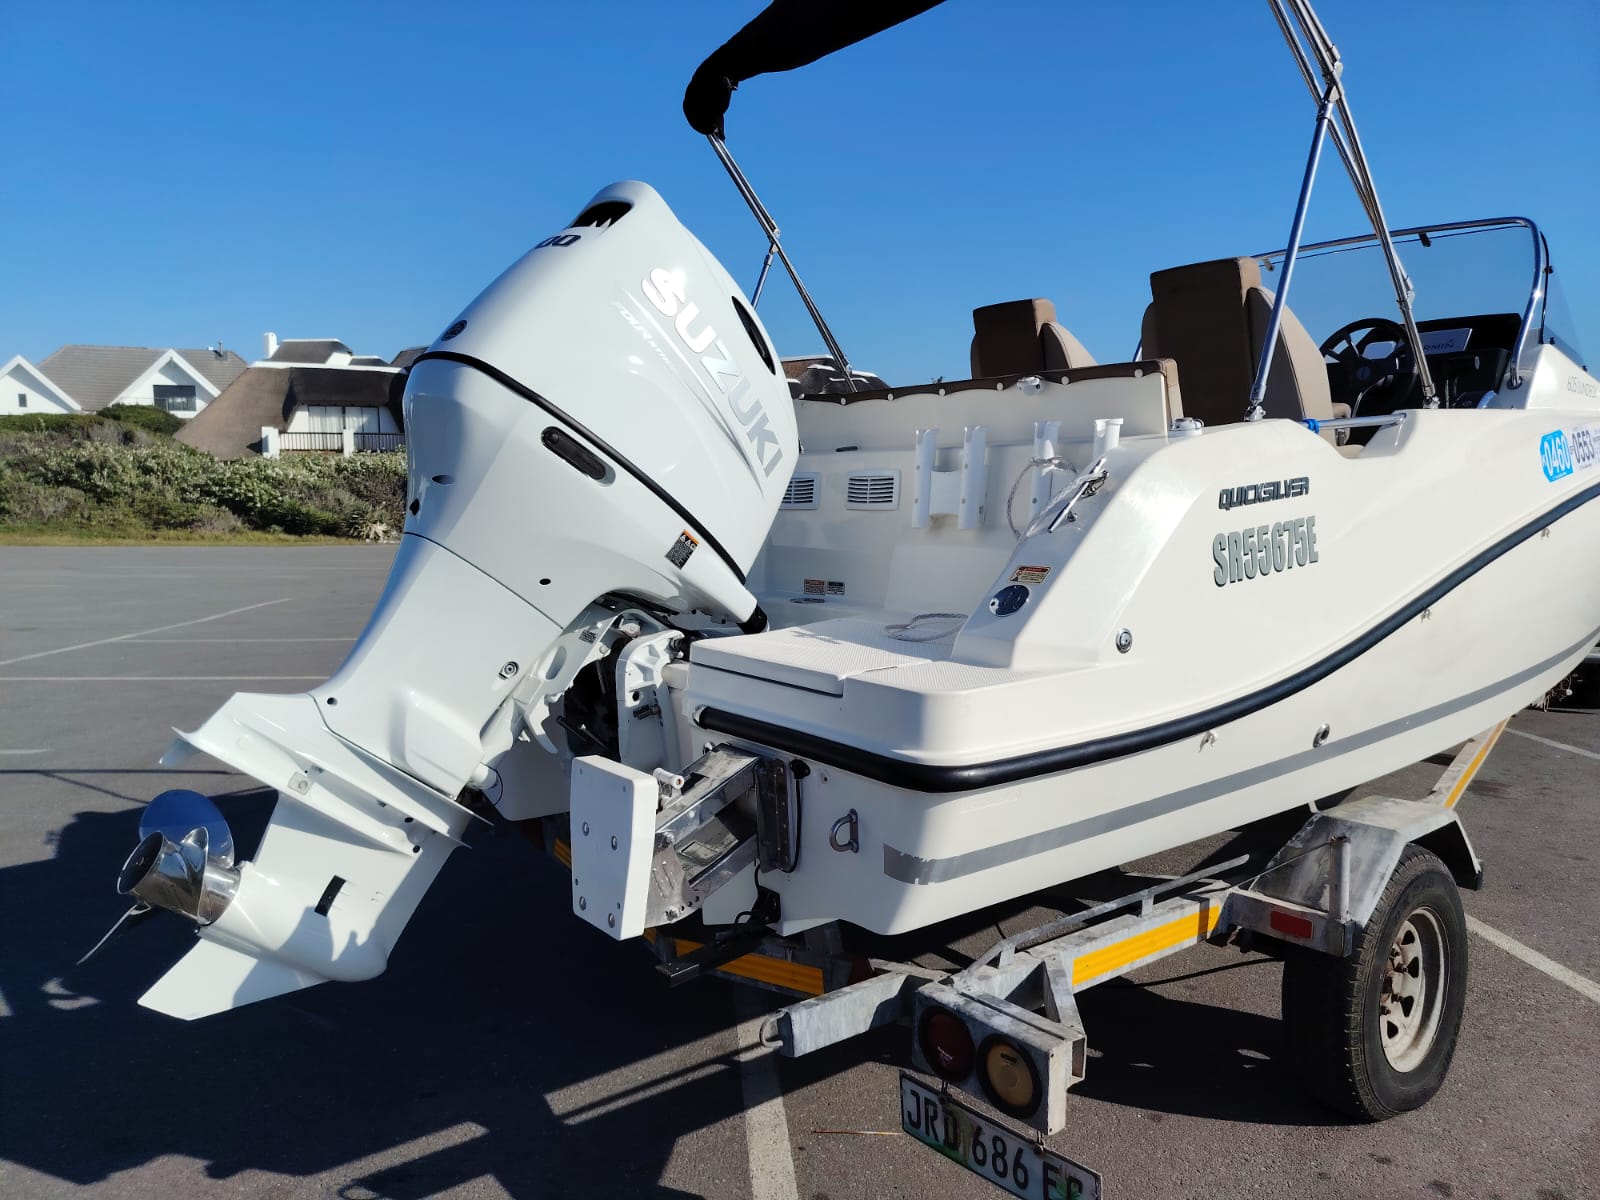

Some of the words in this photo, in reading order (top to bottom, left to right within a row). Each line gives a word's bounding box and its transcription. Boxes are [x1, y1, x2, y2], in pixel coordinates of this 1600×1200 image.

[641, 267, 783, 478] SUZUKI
[1219, 476, 1309, 511] QUICKSILVER
[1212, 515, 1319, 587] SR55675E
[906, 1089, 958, 1149] JRD
[971, 1125, 1029, 1191] 686
